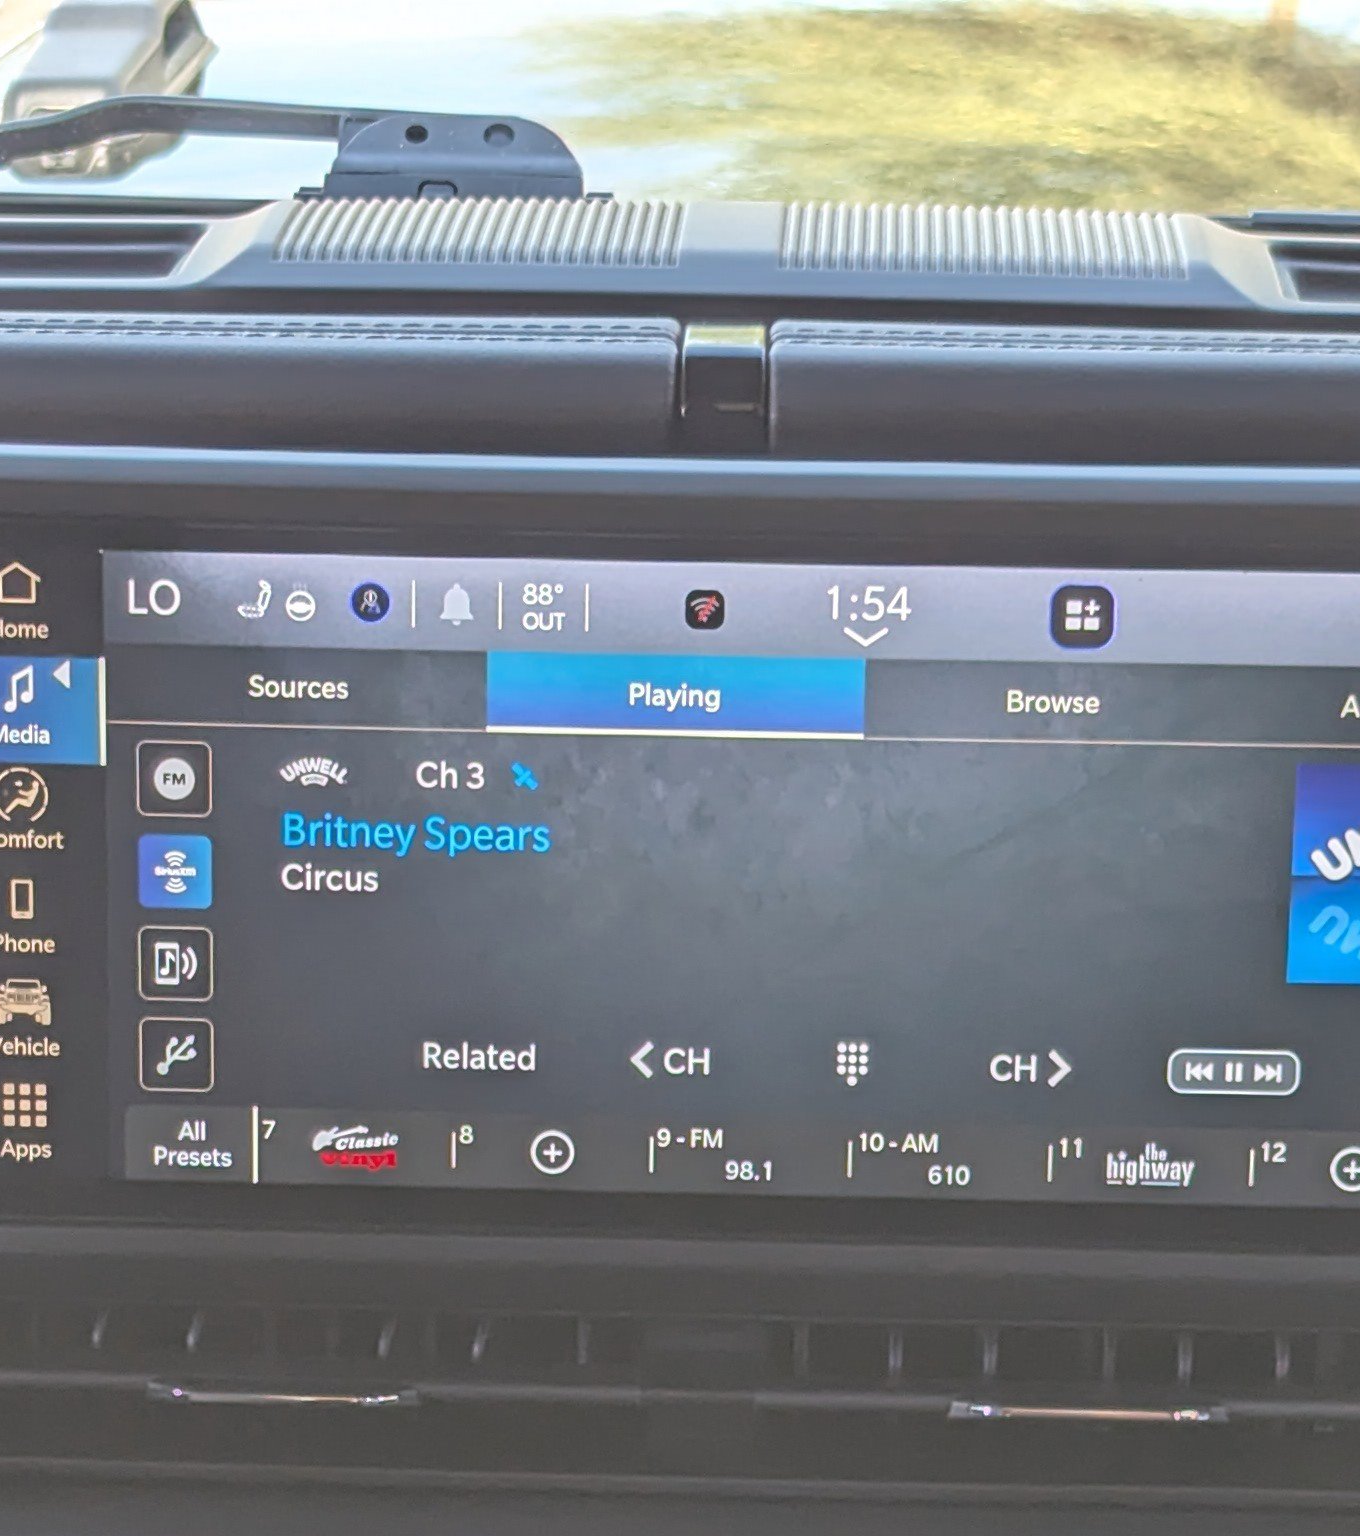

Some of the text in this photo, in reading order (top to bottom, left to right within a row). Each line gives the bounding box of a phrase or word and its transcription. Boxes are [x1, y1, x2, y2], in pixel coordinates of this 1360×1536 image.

[127, 579, 181, 616] LO
[827, 585, 912, 622] 1:54
[522, 612, 566, 632] OUT
[248, 674, 350, 700] Sources
[628, 683, 721, 712] Playing
[1006, 689, 1101, 714] Browse
[162, 773, 186, 786] FM
[279, 757, 348, 785] UNWELL
[416, 761, 485, 790] Ch 3
[282, 811, 551, 859] Britney Spears
[280, 863, 380, 893] Circus
[422, 1042, 537, 1071] Related
[663, 1047, 712, 1076] CH
[989, 1055, 1038, 1082] CH
[177, 1121, 207, 1141] All
[262, 1121, 277, 1139] 7
[334, 1132, 399, 1150] Classic
[458, 1126, 474, 1145] 8
[656, 1130, 671, 1148] 9
[690, 1131, 724, 1149] FM
[0, 1138, 52, 1161] Apps
[859, 1134, 885, 1153] 10
[901, 1135, 939, 1154] AM
[1058, 1139, 1084, 1158] 11
[1144, 1142, 1168, 1161] the
[1261, 1143, 1286, 1163] 12
[153, 1147, 233, 1168] Presets
[725, 1162, 772, 1182] 98.1
[927, 1165, 971, 1186] 610
[1105, 1151, 1196, 1187] highway
